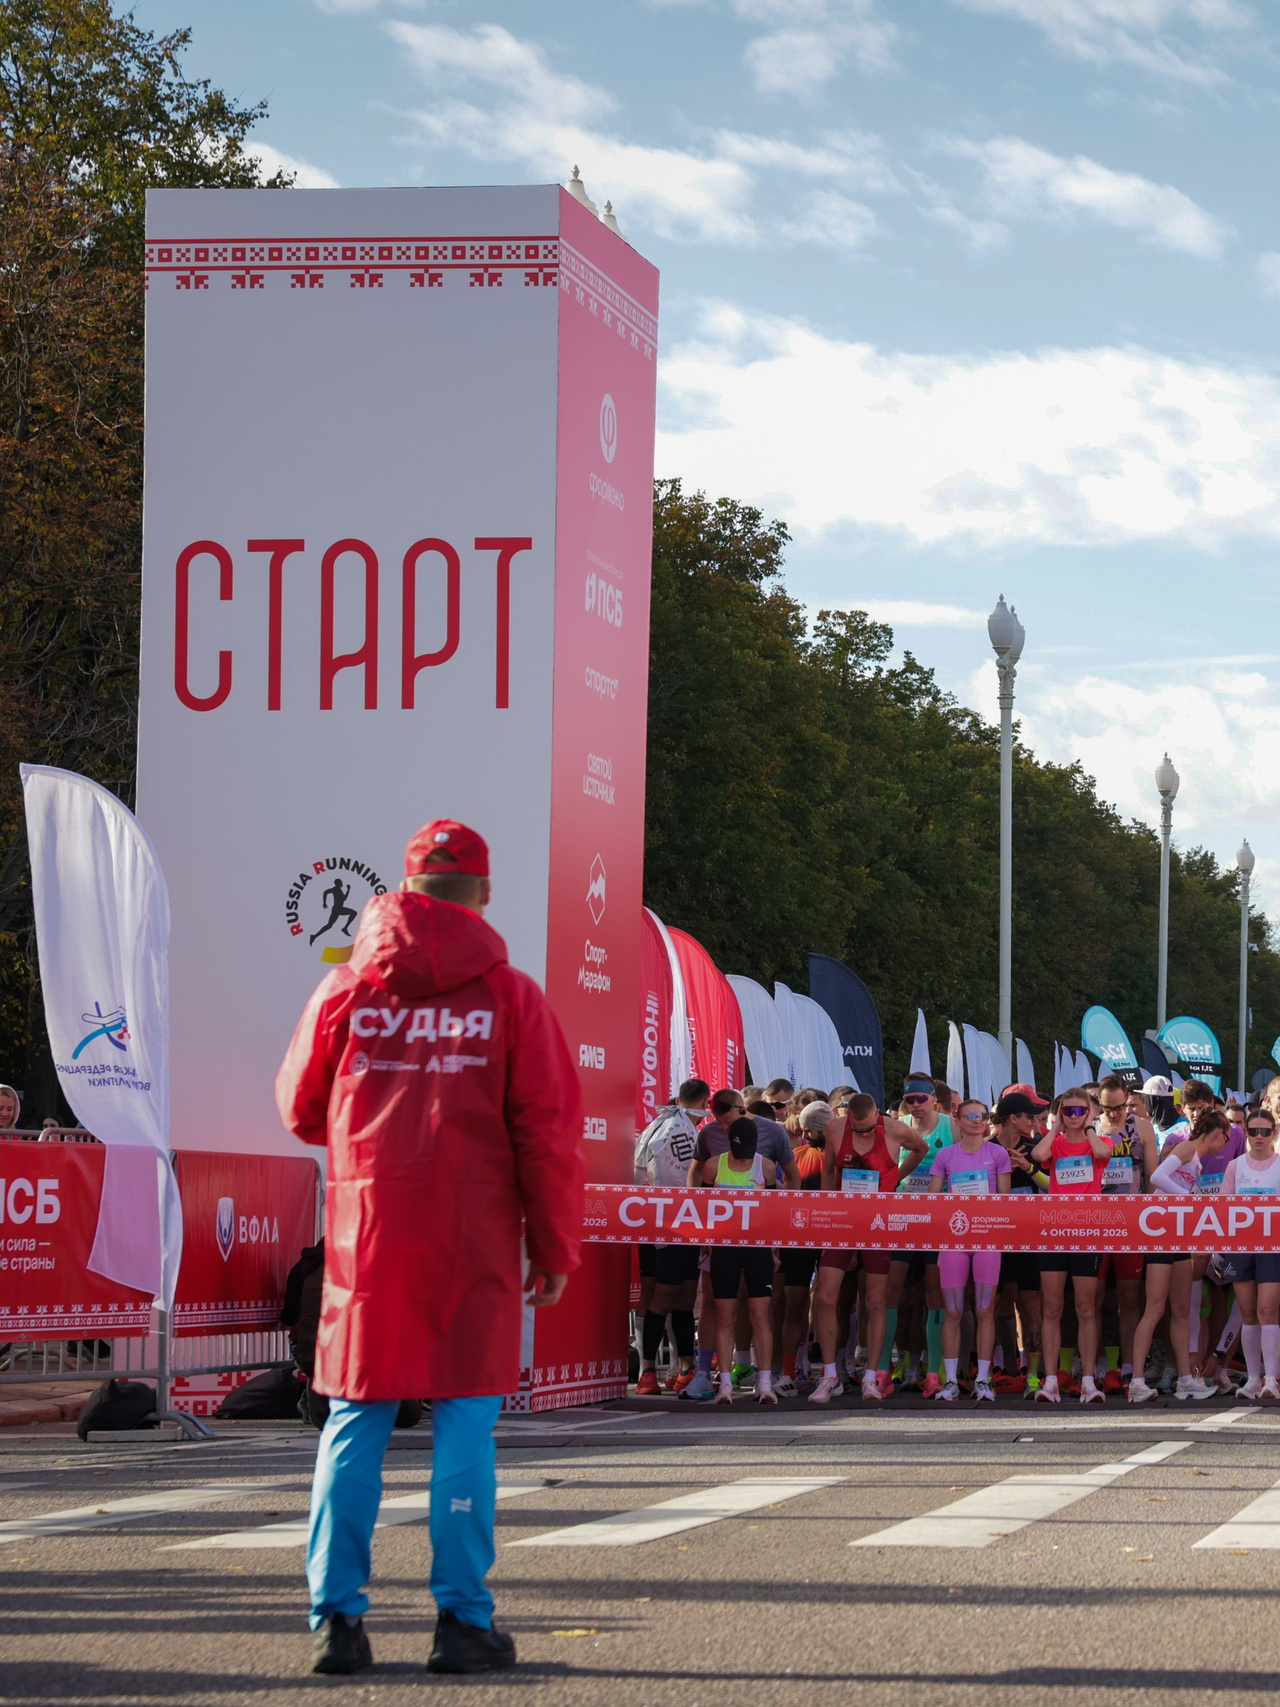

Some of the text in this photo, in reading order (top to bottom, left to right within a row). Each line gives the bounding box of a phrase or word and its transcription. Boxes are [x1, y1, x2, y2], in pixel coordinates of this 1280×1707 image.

[598, 578, 623, 628] ПСБ
[174, 537, 533, 712] СТАРТ
[312, 857, 388, 896] RUNNING
[286, 872, 313, 937] RUSSIA
[578, 964, 611, 993] Марафон
[353, 1007, 494, 1044] СУДЬЯ
[1060, 1170, 1086, 1179] 23923
[618, 1196, 760, 1231] СТАРТ
[811, 1209, 848, 1217] Департамент
[888, 1213, 931, 1223] МОСКОВСКИЙ
[971, 1216, 1010, 1226] фармэко
[1040, 1209, 1127, 1225] МОСКВА
[1138, 1205, 1280, 1237] СТАРТ
[239, 1215, 279, 1245] ВФЛА
[582, 1218, 608, 1227] 2026
[888, 1223, 908, 1231] СПОРТ
[1040, 1228, 1128, 1237] 4 ОКТЯБРЯ 2026
[6, 1239, 36, 1251] сила
[10, 1257, 56, 1274] страны
